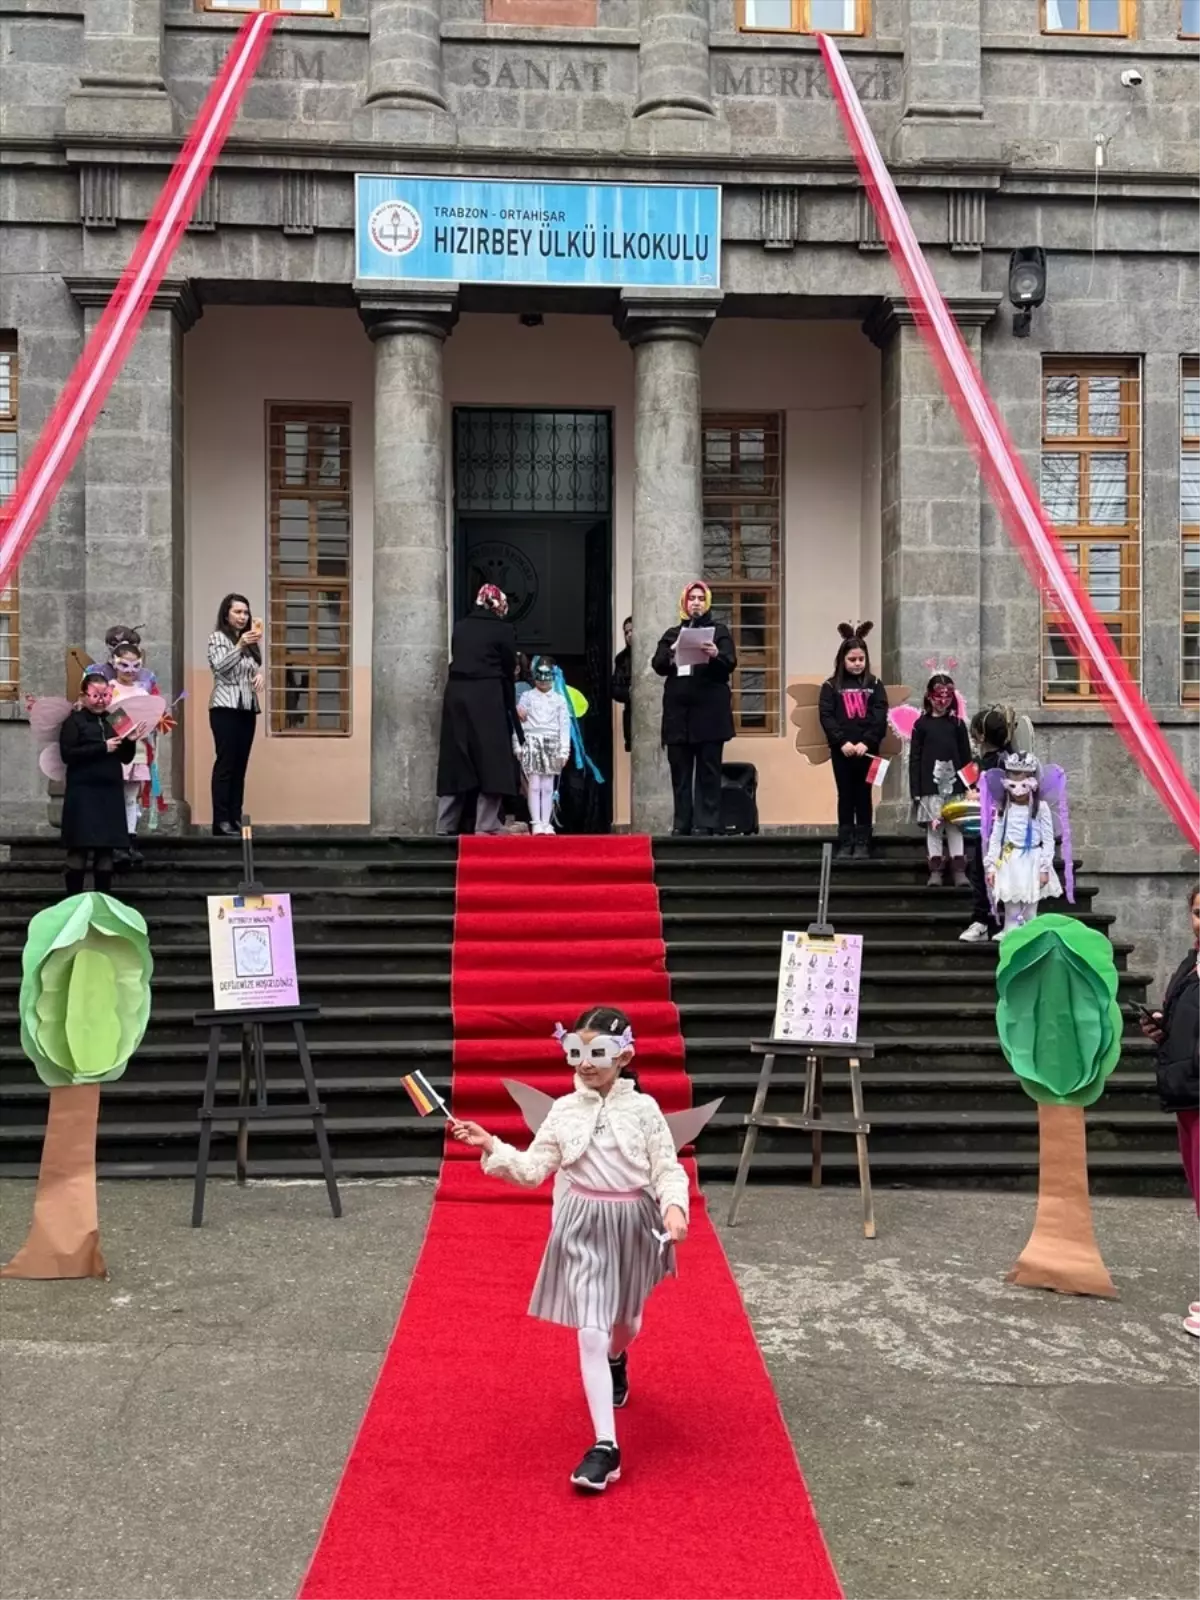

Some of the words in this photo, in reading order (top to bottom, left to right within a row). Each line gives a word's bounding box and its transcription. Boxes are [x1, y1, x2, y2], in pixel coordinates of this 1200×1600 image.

[471, 58, 607, 91] SANAT
[717, 62, 892, 100] MERKZİ
[434, 206, 489, 219] TRABZON
[499, 208, 566, 222] ORTAHİSAR
[434, 226, 533, 256] HIZIRBEY
[539, 222, 596, 258] ÜLKÜ
[603, 223, 709, 261] İLKOKULU
